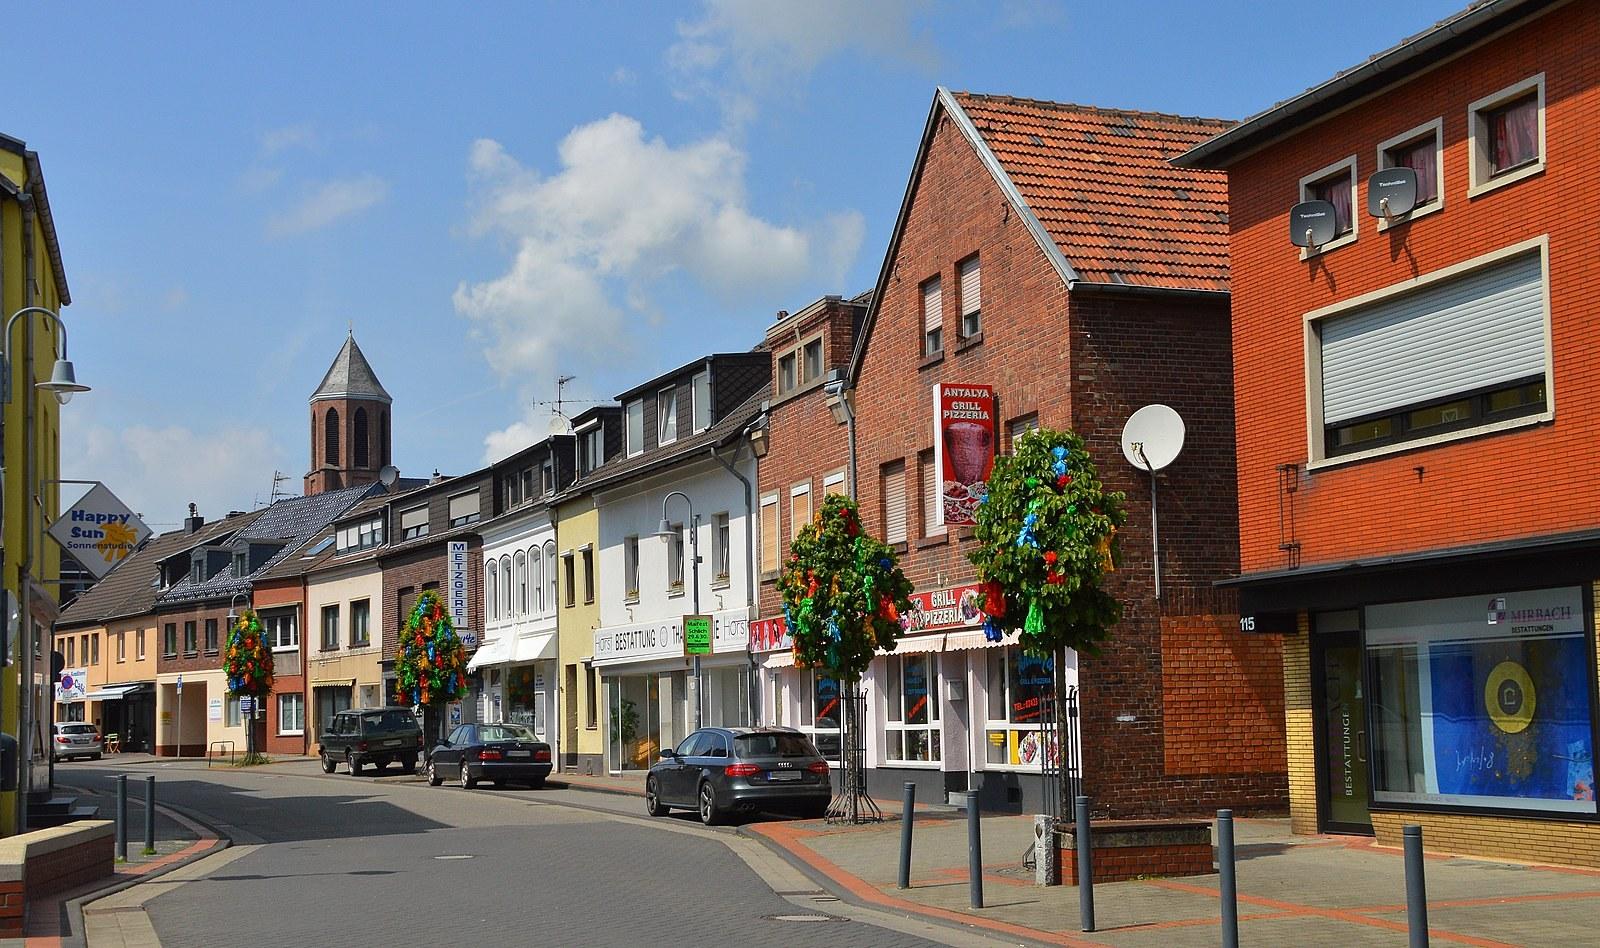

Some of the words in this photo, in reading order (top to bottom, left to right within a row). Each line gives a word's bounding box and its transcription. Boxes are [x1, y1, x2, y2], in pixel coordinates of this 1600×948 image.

[943, 387, 989, 398] ANTALYA
[952, 401, 981, 410] GRILL
[943, 410, 989, 419] PIZZERIA
[72, 510, 130, 525] Happy
[71, 526, 104, 539] Sun
[67, 541, 133, 549] Sonnenstudio
[453, 543, 465, 625] METZGEREI
[930, 589, 956, 608] GRILL
[924, 607, 965, 626] PIZZERIA
[1511, 606, 1571, 622] MIRBACH
[1240, 616, 1255, 631] 115
[1511, 625, 1554, 634] BESTATTUNGEN
[615, 628, 656, 651] BESTATTUNG
